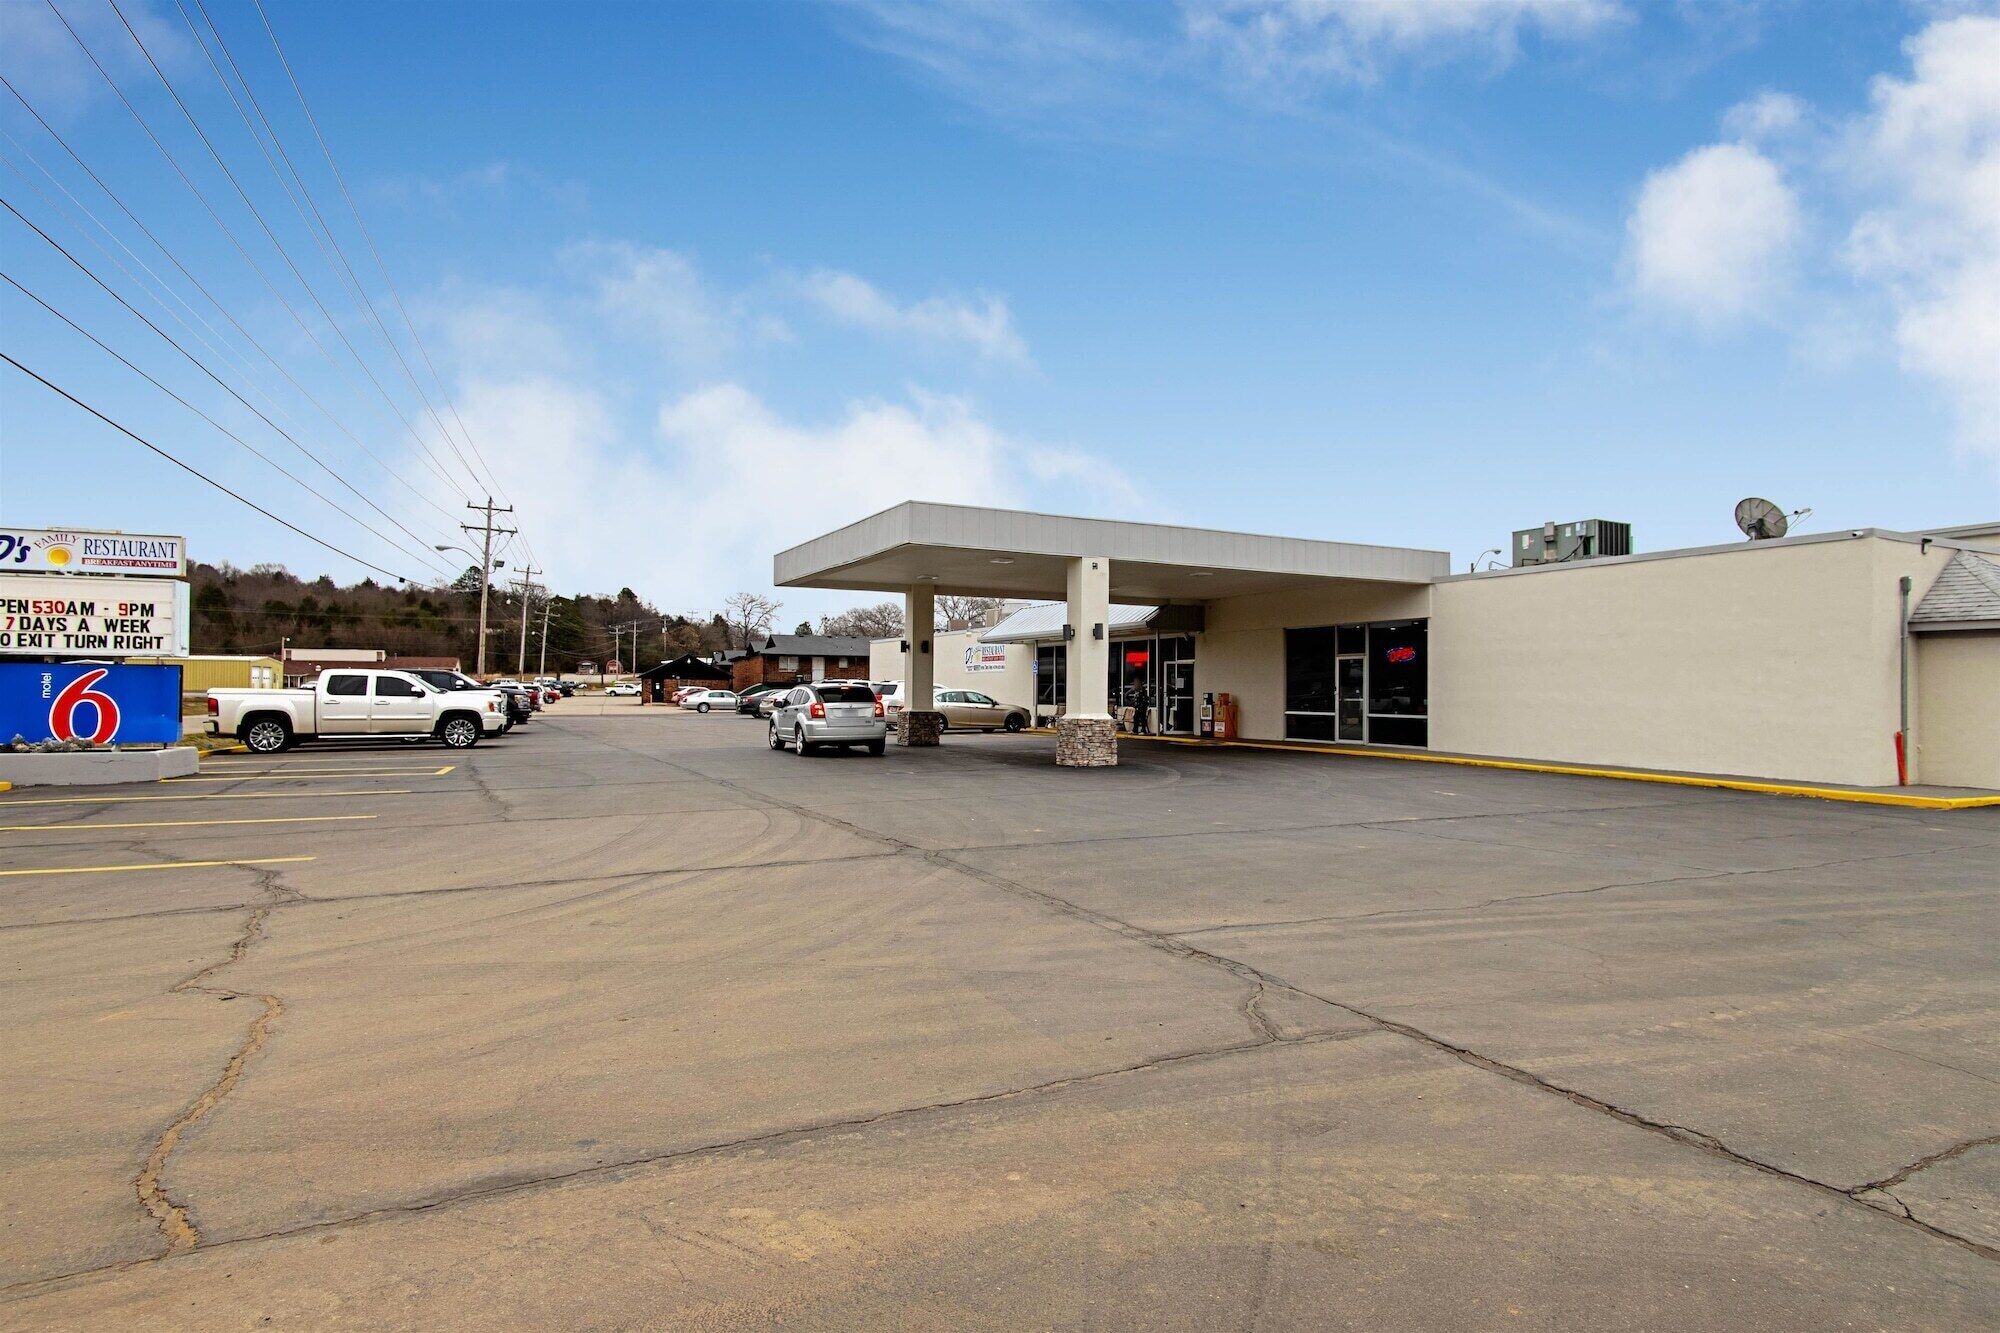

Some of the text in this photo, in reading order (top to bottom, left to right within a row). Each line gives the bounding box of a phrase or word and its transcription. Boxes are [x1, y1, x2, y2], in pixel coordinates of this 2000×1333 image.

[34, 533, 80, 548] FAMILY
[83, 538, 177, 559] RESTAURANT
[84, 558, 175, 569] BREAKFAST ANYTIME
[32, 600, 95, 616] 530AM
[118, 603, 154, 617] 9PM
[6, 616, 151, 633] 7 DAYS A WEEK
[17, 633, 56, 648] EXIT
[63, 634, 107, 649] TURN
[113, 636, 164, 650] RIGHT
[41, 673, 52, 699] motel
[49, 668, 121, 744] 6
